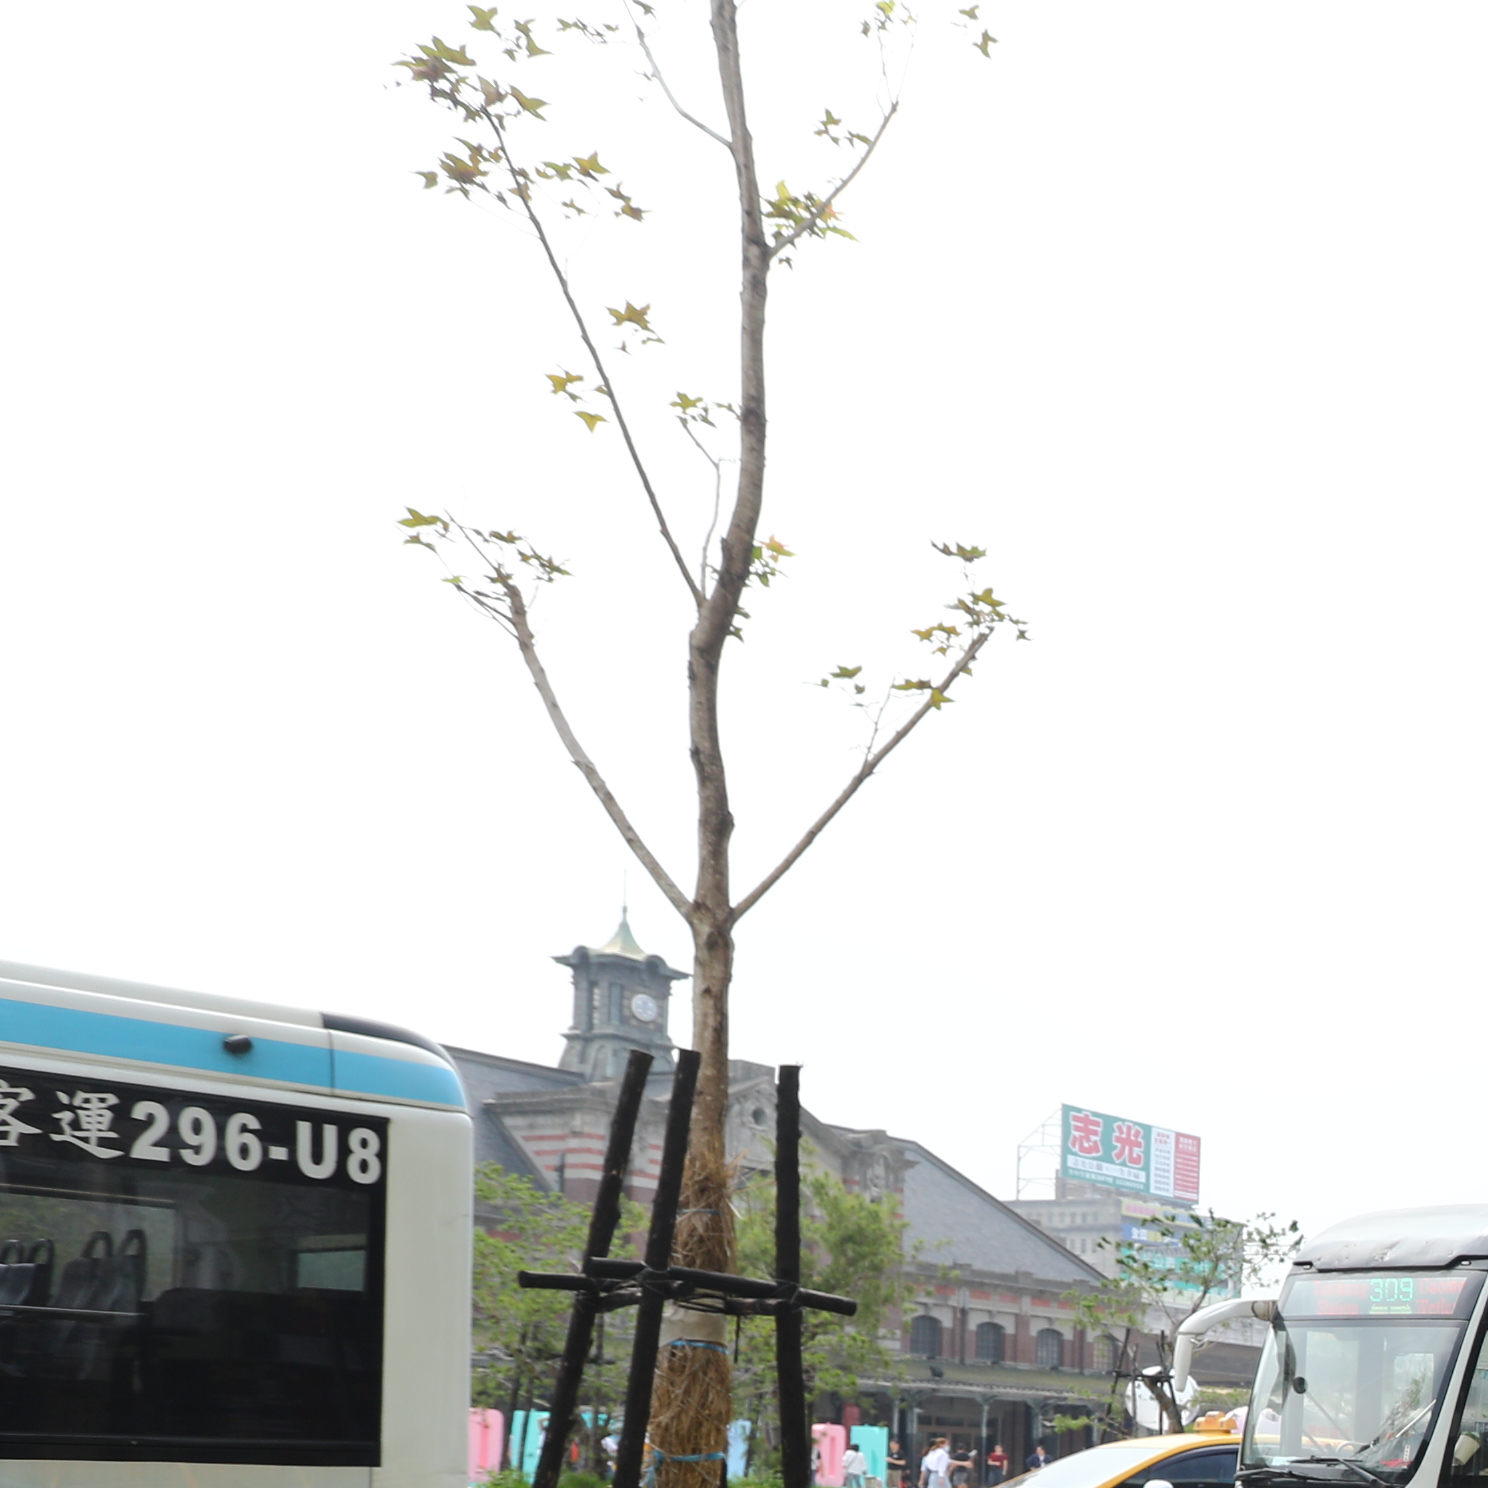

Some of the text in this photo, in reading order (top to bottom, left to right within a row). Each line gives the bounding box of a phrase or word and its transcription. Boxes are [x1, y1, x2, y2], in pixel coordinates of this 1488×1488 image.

[129, 1100, 382, 1186] 296-U8
[1069, 1111, 1144, 1168] 志光
[1369, 1277, 1414, 1301] 309
